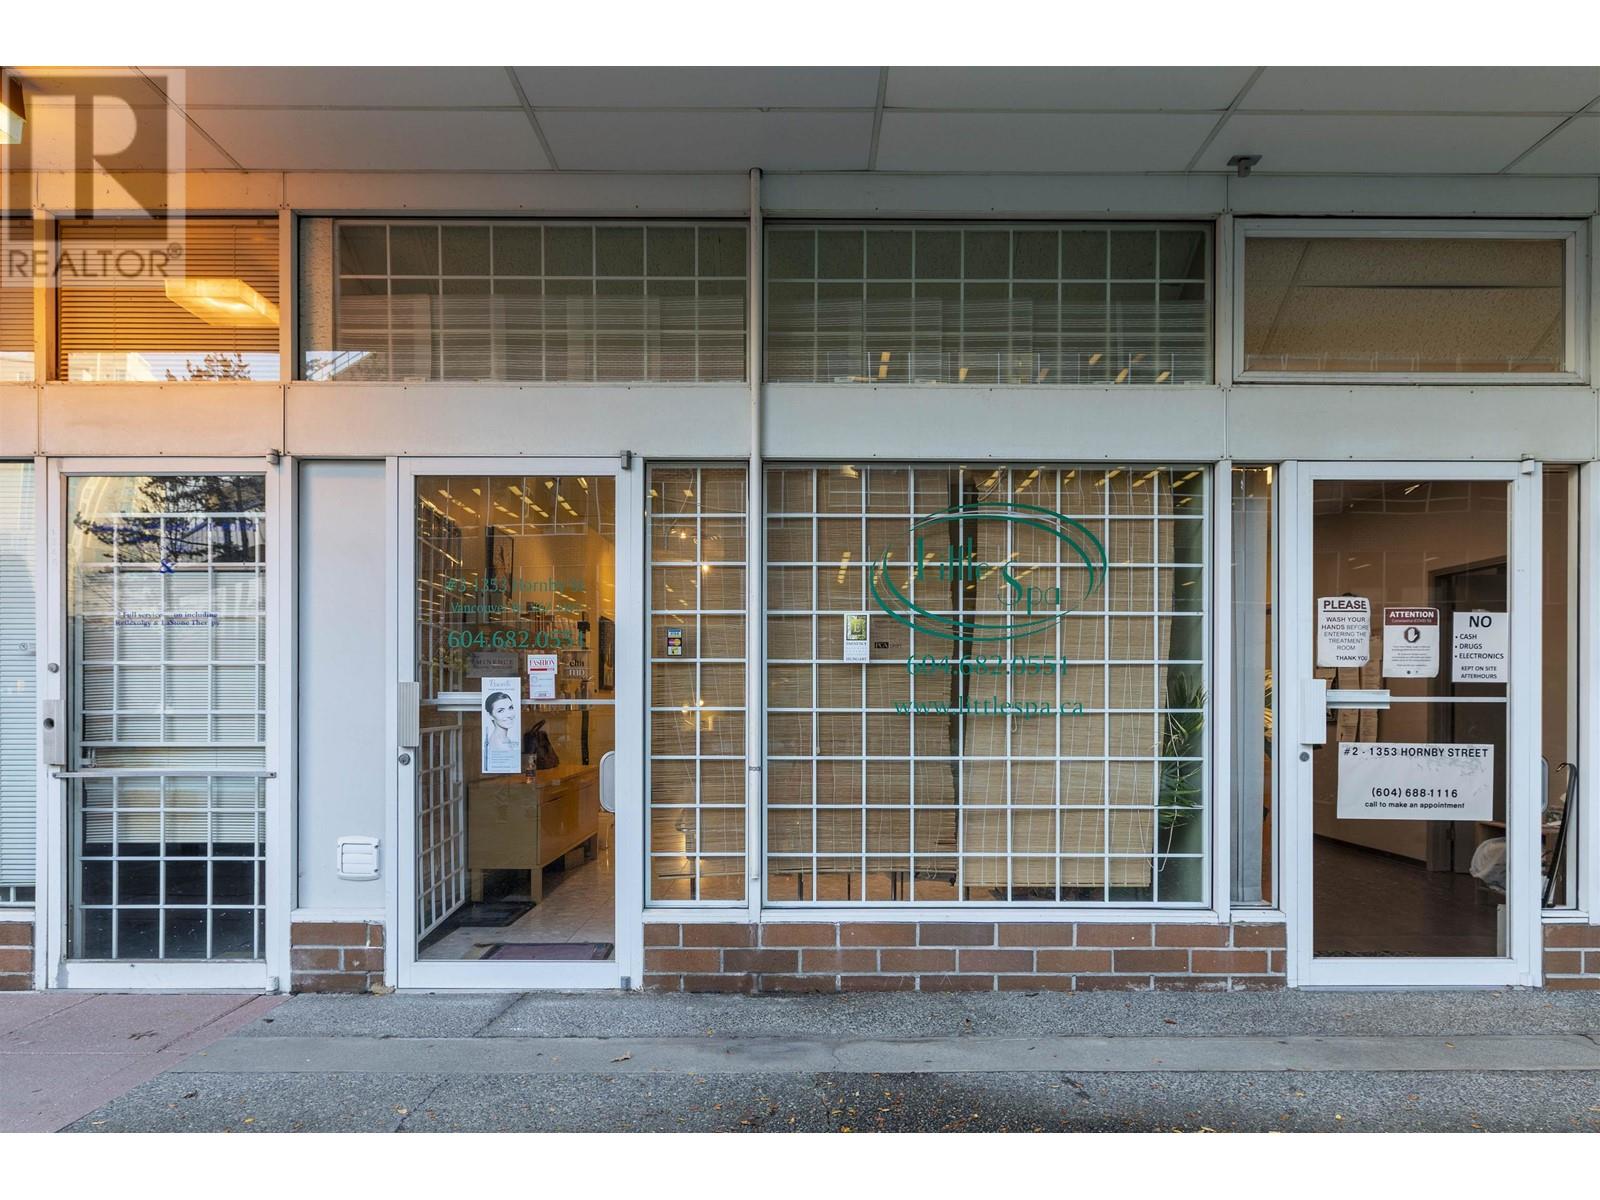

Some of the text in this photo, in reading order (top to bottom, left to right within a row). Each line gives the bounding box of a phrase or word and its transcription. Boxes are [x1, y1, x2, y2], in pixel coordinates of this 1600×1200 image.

[998, 559, 1061, 616] Spa
[1323, 600, 1367, 610] PLEASE
[192, 619, 219, 627] Therpy
[1469, 615, 1492, 628] NO
[448, 629, 585, 649] 604.682.0551
[1459, 652, 1505, 660] ELECTRONICS
[906, 654, 1068, 676] 604.682.0551
[894, 695, 1084, 721] www.littlespa.ca
[1369, 747, 1398, 756] 1353
[1400, 748, 1445, 757] HORNBY
[1447, 748, 1489, 758] STREET
[1371, 787, 1458, 798] (604) 688-1116
